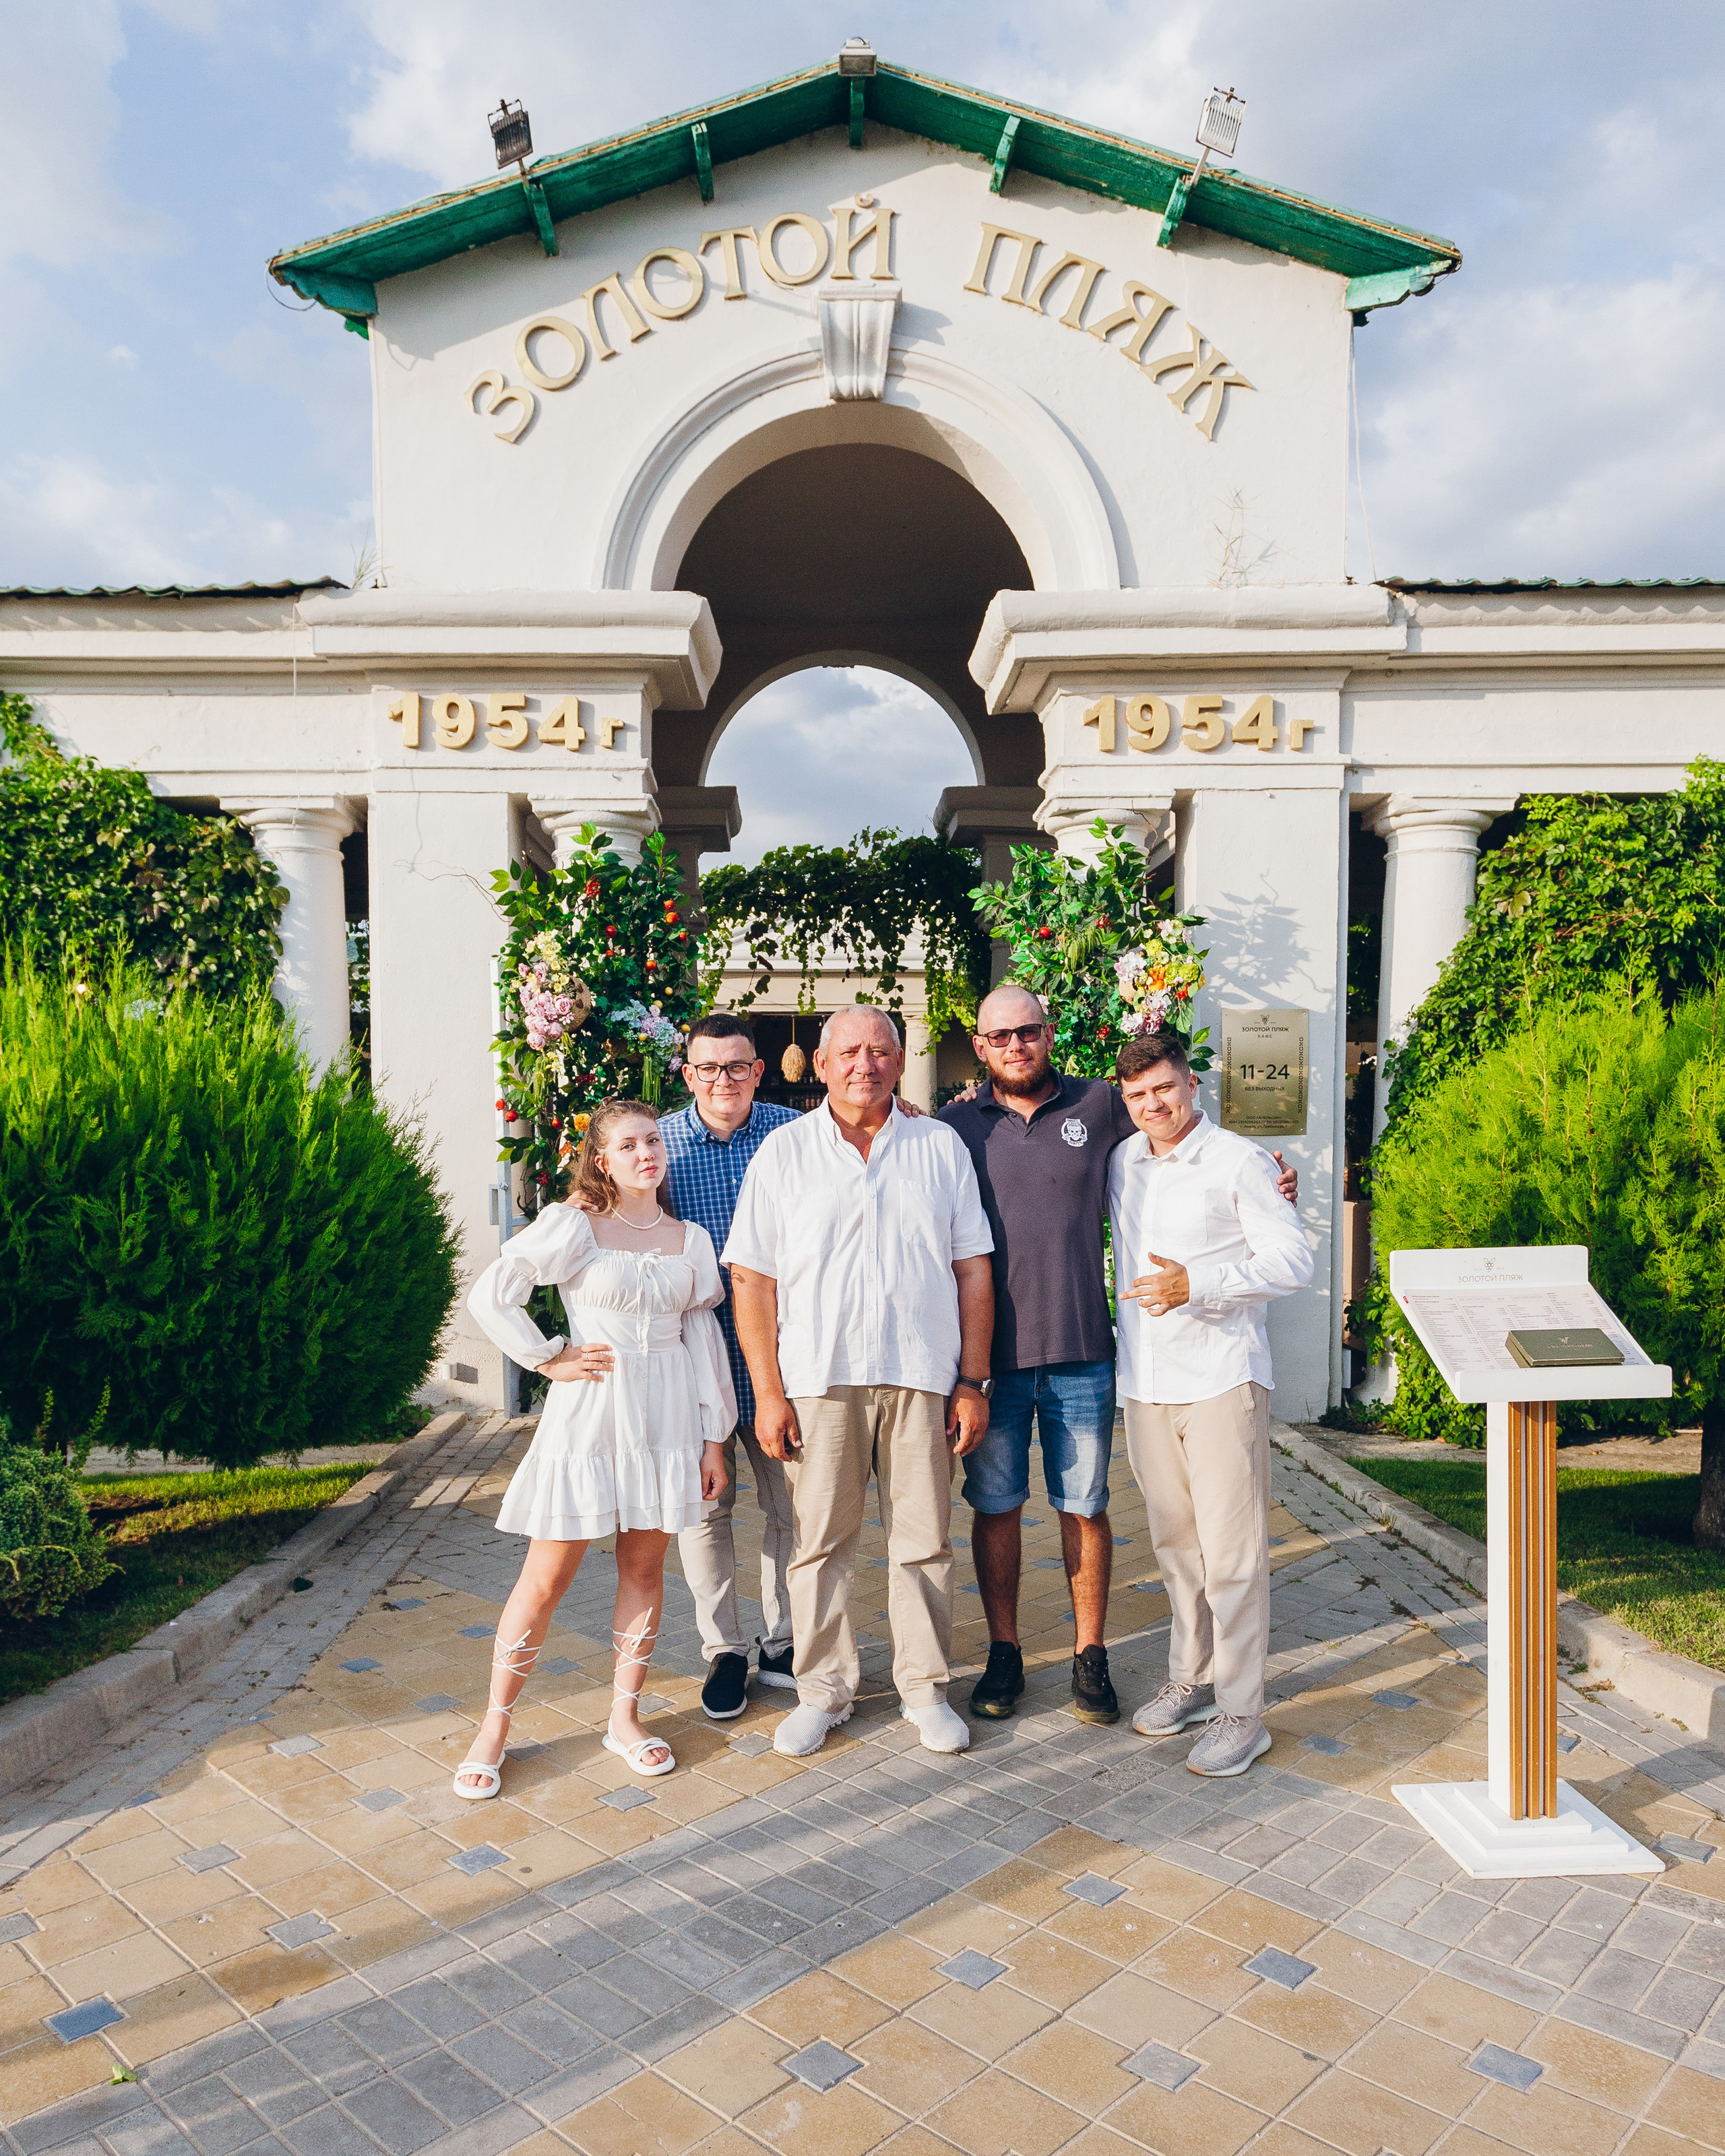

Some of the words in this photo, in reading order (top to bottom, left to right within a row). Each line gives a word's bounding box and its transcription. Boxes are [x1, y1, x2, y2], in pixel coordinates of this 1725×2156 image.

[464, 193, 895, 444] ЗОЛОТОЙ
[964, 222, 1254, 442] ПЛЯЖ
[387, 692, 586, 751] 1954
[600, 718, 625, 749] г
[1083, 694, 1278, 752] 1954
[1290, 719, 1315, 751] г
[1240, 1064, 1290, 1079] 11-24
[1457, 1274, 1497, 1283] ЗОЛОТОЙ
